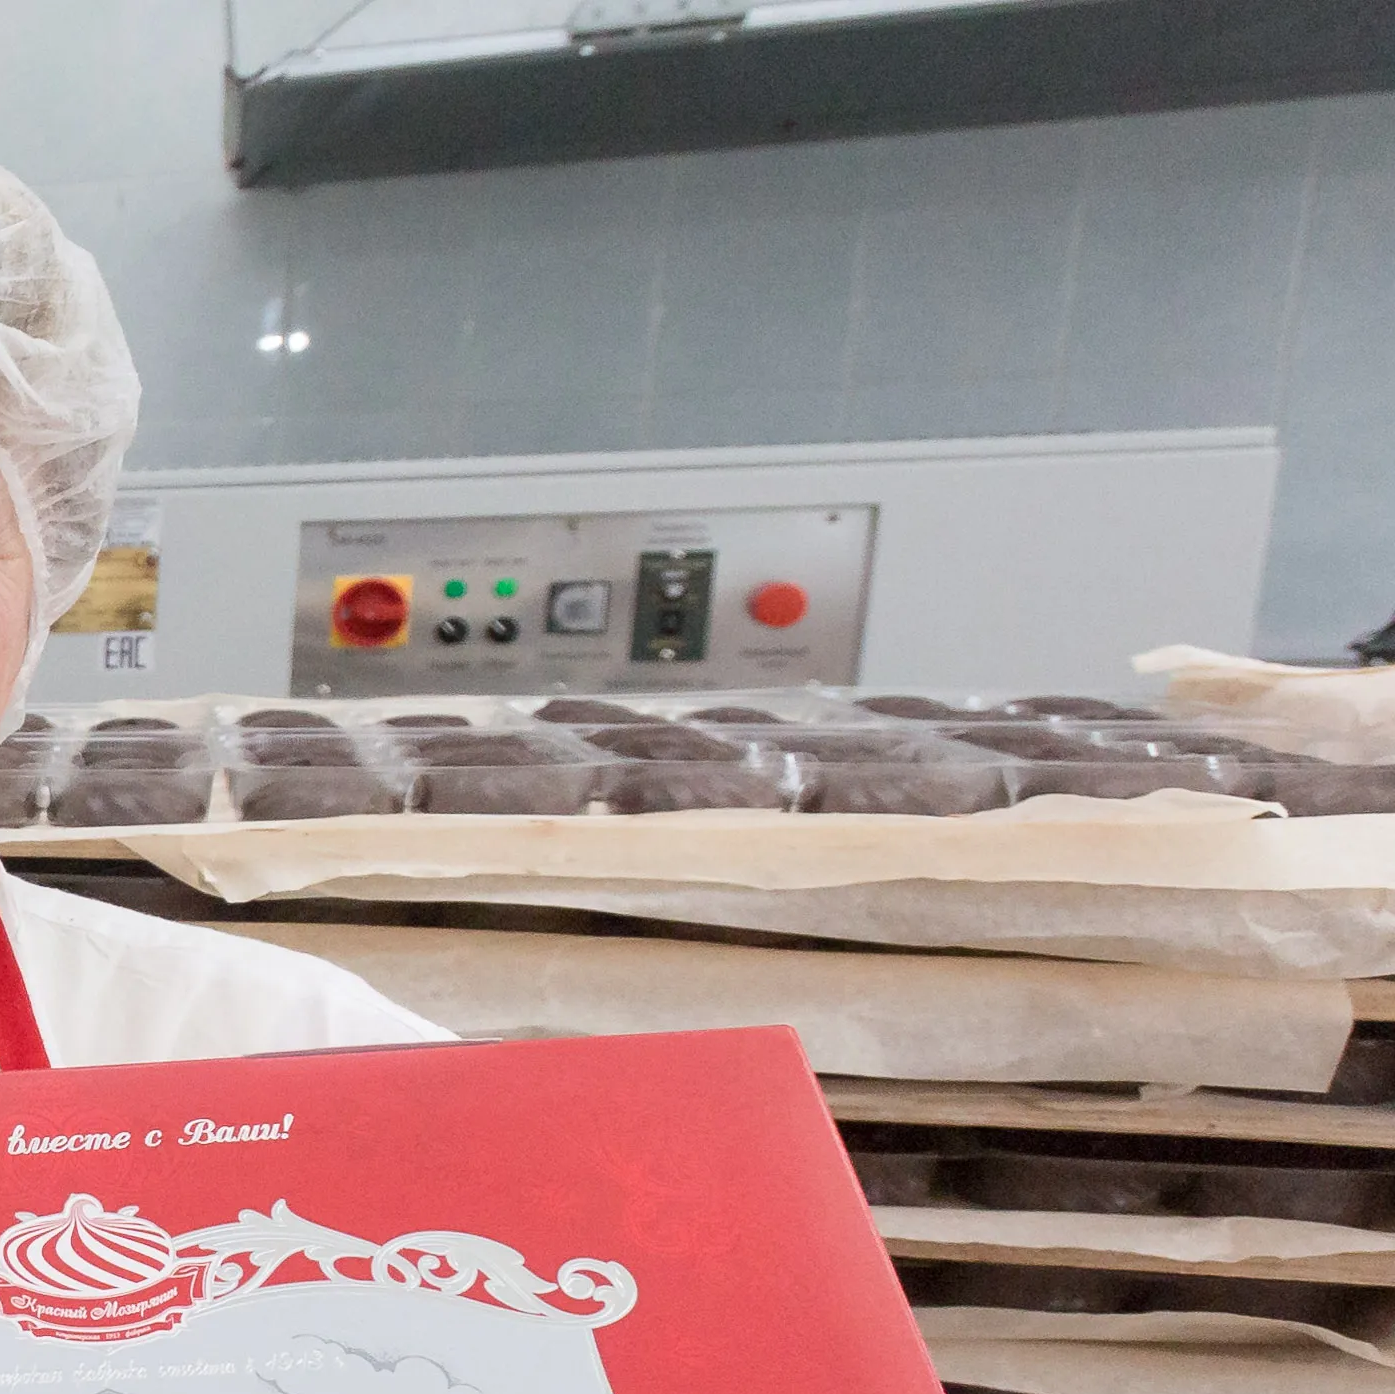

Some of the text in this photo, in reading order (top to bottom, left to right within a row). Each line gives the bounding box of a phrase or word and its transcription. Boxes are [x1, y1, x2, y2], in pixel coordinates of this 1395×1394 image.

[6, 1125, 132, 1156] вместе
[144, 1131, 163, 1148] с
[177, 1113, 295, 1147] Вами!
[10, 1294, 88, 1320] Красный
